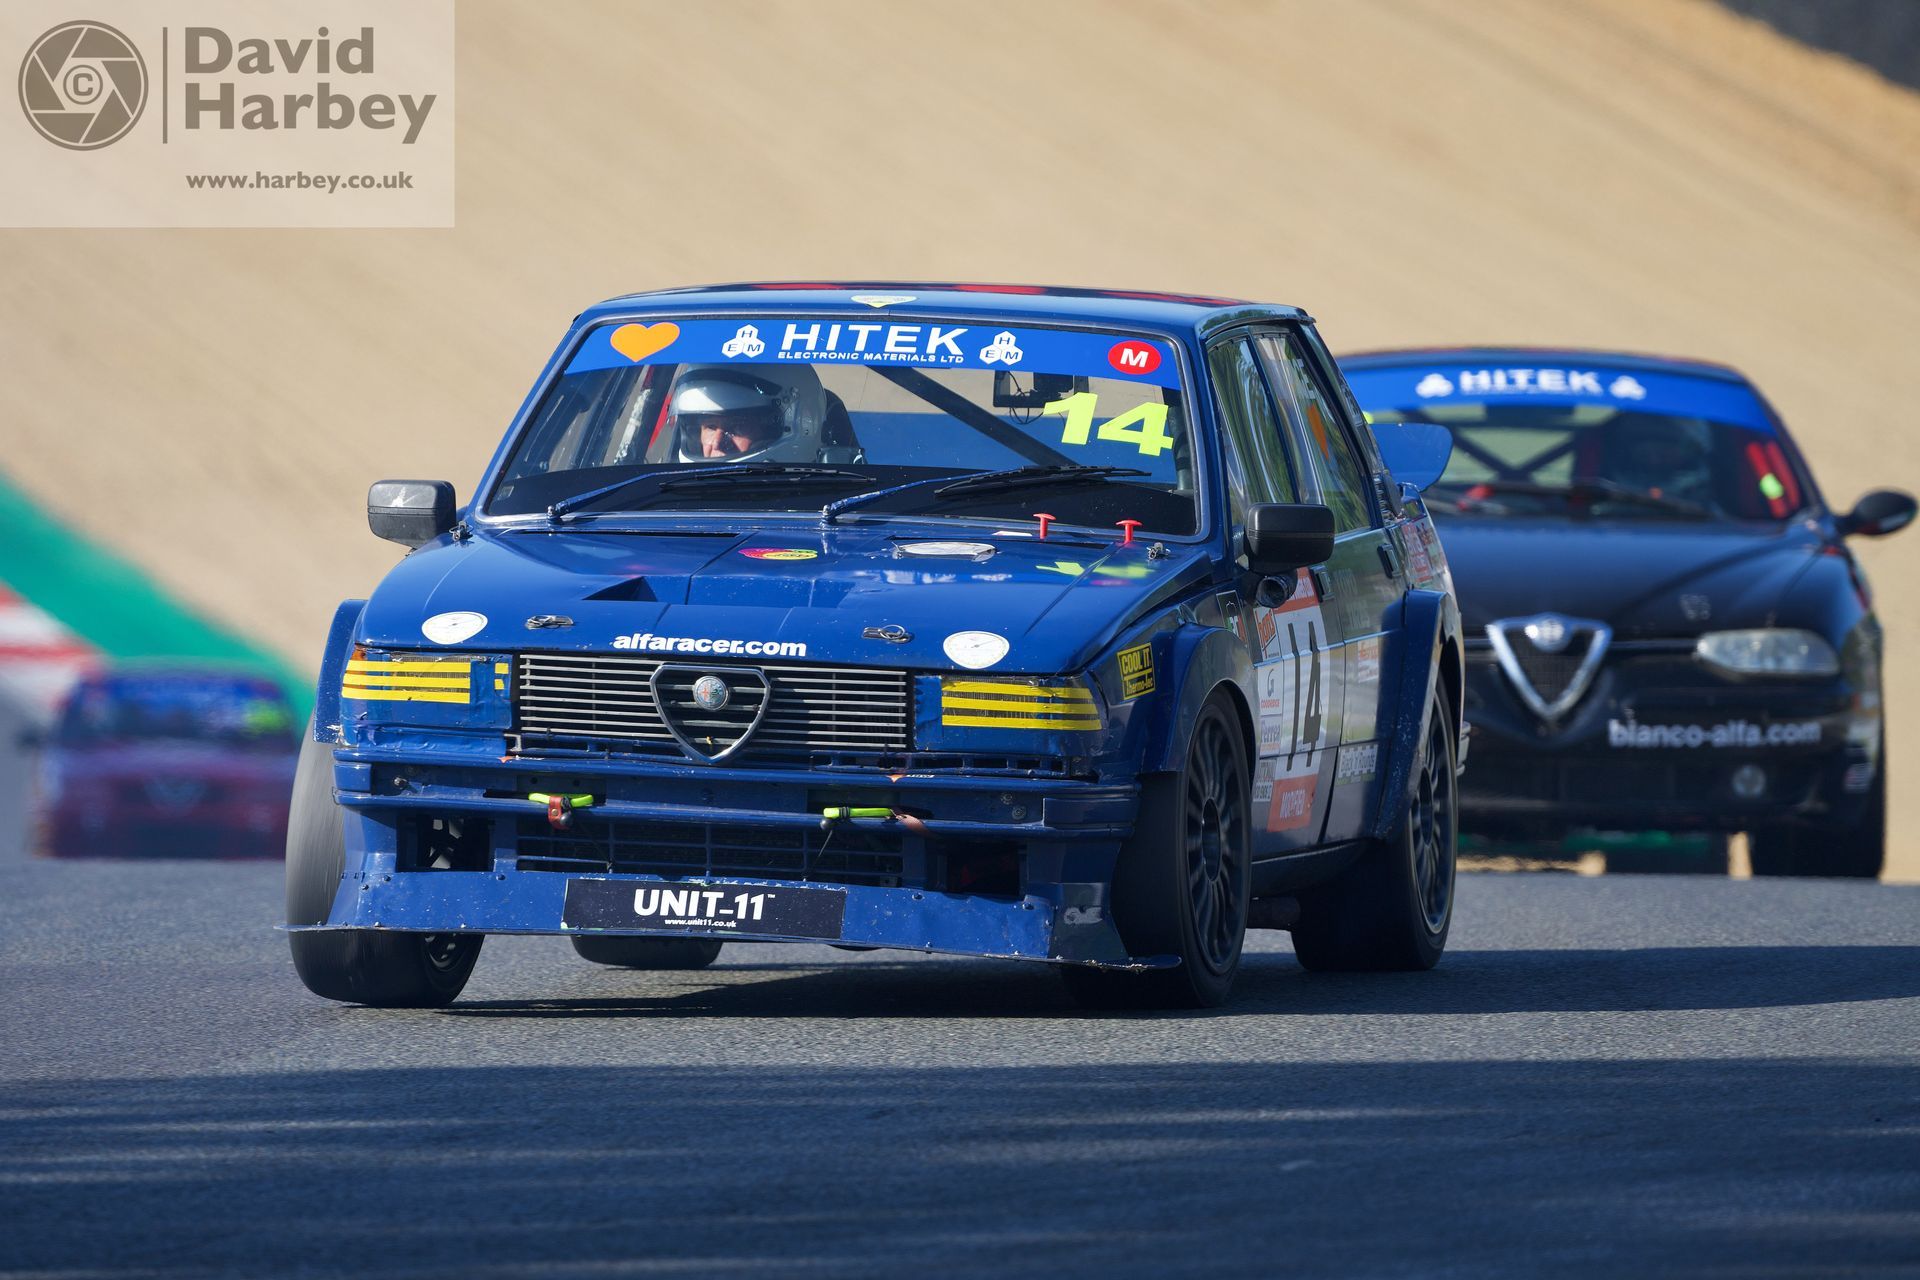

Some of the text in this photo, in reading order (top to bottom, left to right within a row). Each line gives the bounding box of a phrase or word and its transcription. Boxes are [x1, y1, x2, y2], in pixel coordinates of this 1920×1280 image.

[781, 323, 968, 355] HITEK
[778, 351, 964, 363] ELECTRONIC MATERIALS LTD
[1119, 348, 1149, 368] M
[1459, 369, 1603, 393] HITEK
[1043, 392, 1174, 457] 14
[612, 633, 807, 657] alfaracer.com
[1121, 647, 1151, 675] COOL IT
[1607, 719, 1822, 748] bianco-alfa.com
[664, 918, 737, 928] www.unit11.co.uk
